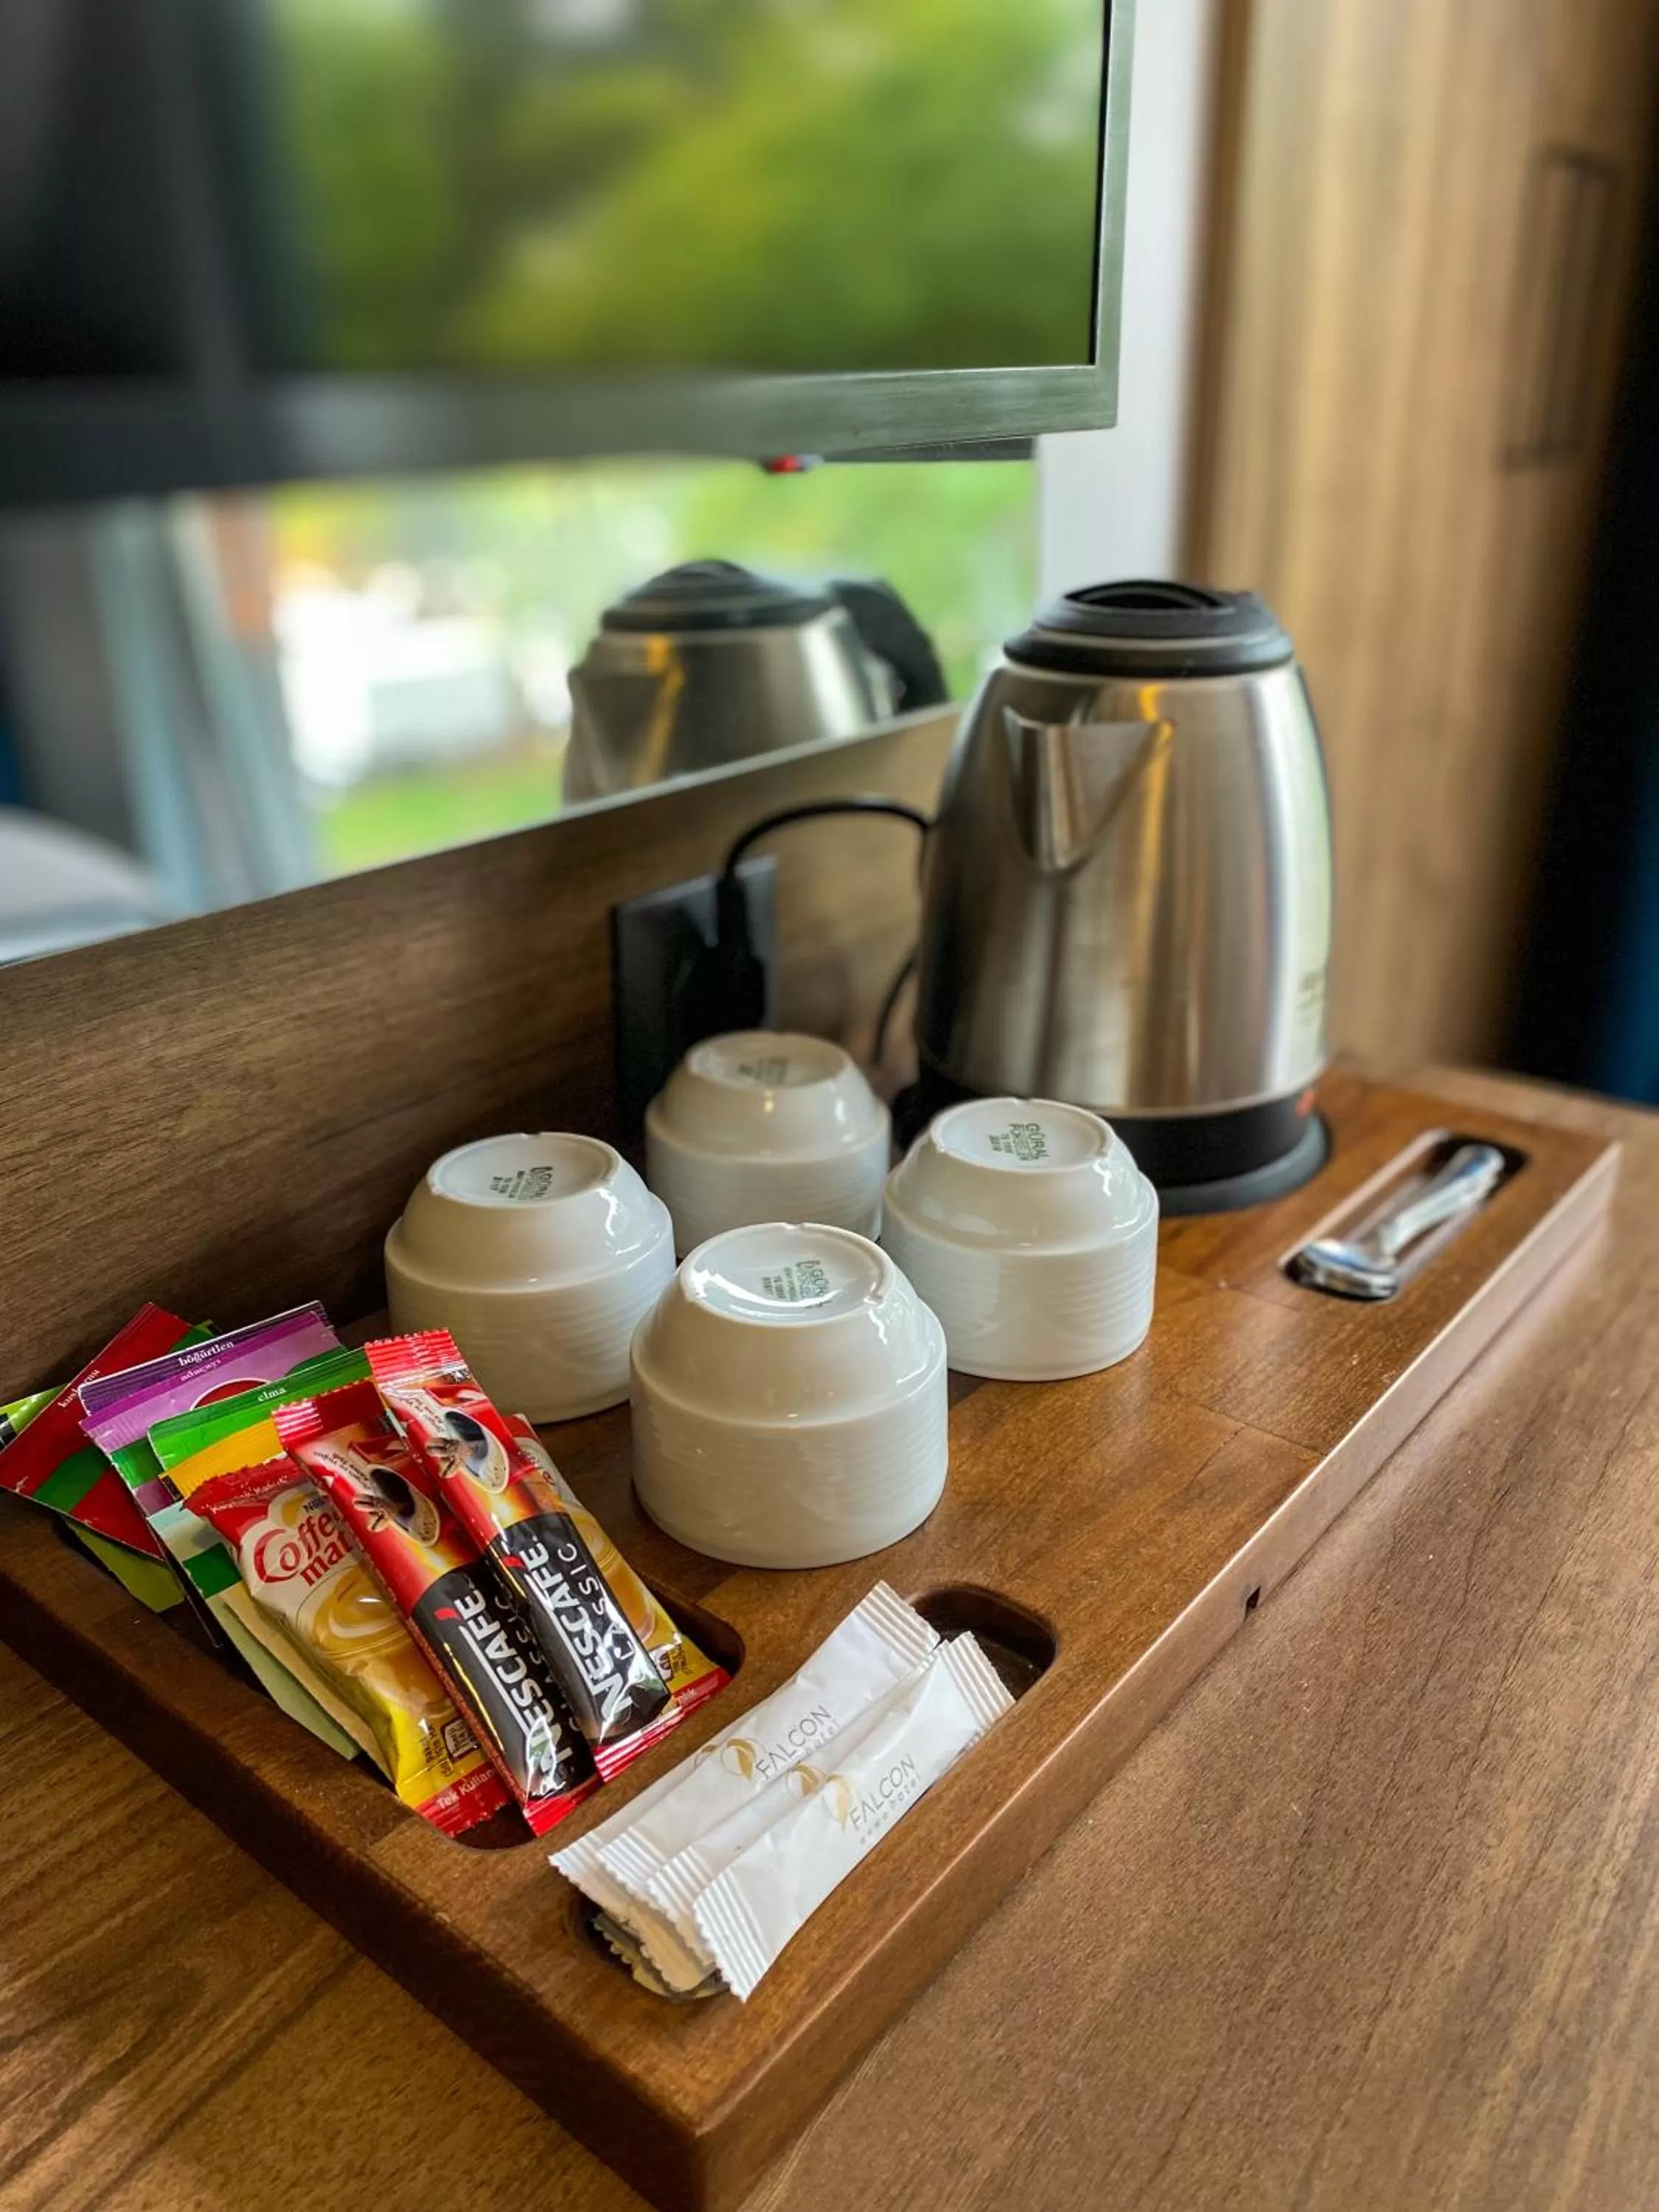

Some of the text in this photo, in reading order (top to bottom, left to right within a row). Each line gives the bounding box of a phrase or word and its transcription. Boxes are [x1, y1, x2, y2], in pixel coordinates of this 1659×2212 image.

[258, 1387, 286, 1402] elma
[254, 1513, 338, 1583] Coffe
[300, 1531, 352, 1587] mat
[756, 1705, 832, 1780] FALCON
[459, 1769, 495, 1795] Kullan
[849, 1753, 916, 1831] FALCON
